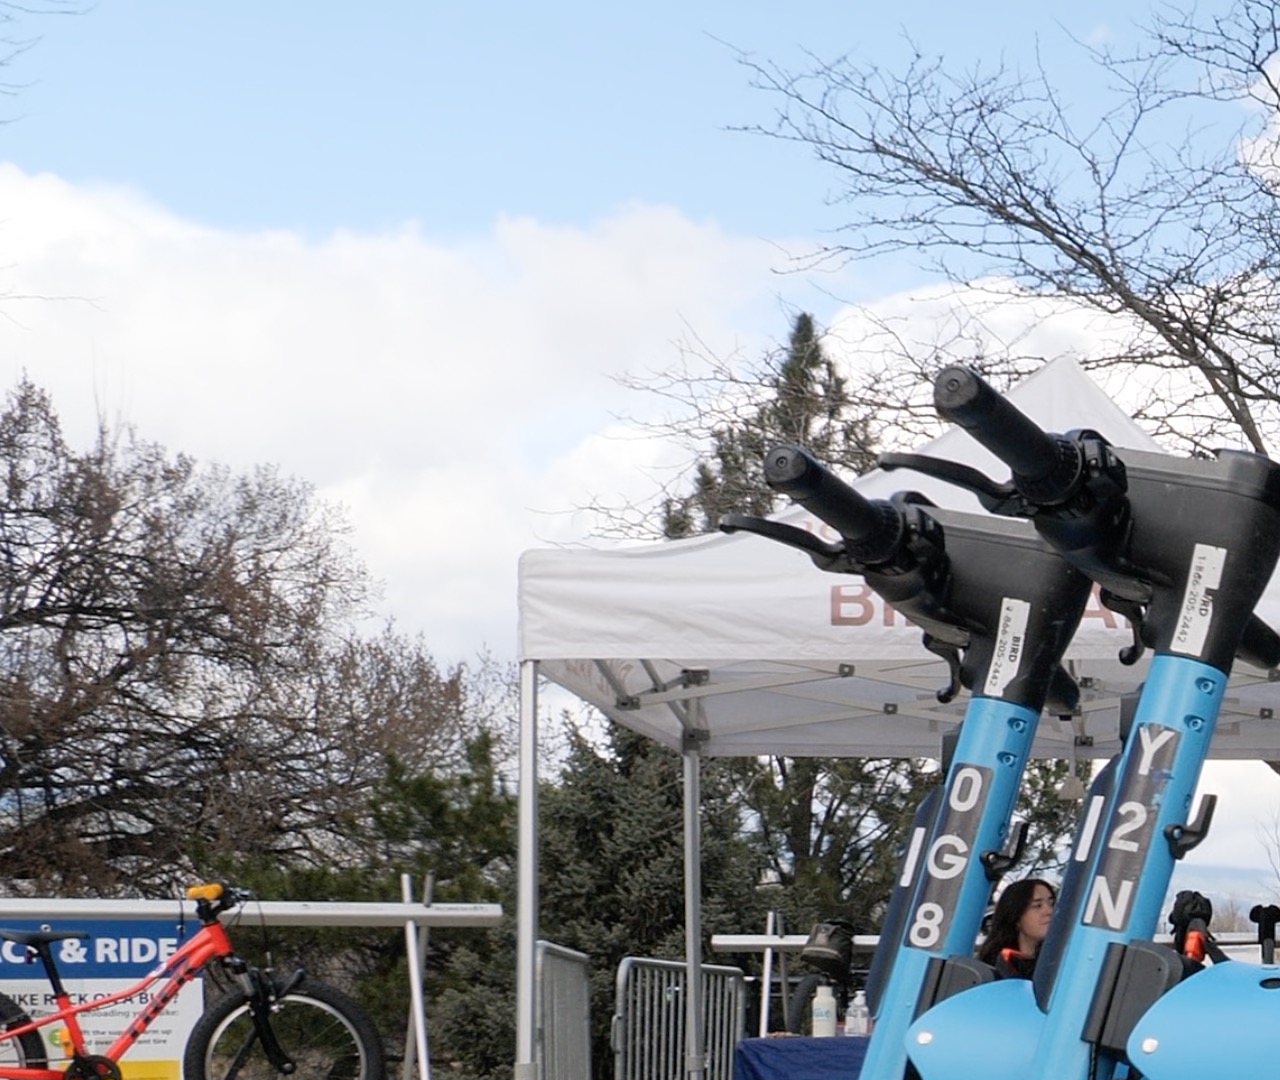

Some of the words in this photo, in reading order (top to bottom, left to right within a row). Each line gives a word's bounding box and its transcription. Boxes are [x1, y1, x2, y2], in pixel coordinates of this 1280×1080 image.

[1009, 635, 1021, 662] BIRD
[60, 937, 87, 963] &
[95, 938, 178, 963] RIDE
[13, 993, 39, 1006] IKE
[44, 993, 88, 1006] RCK
